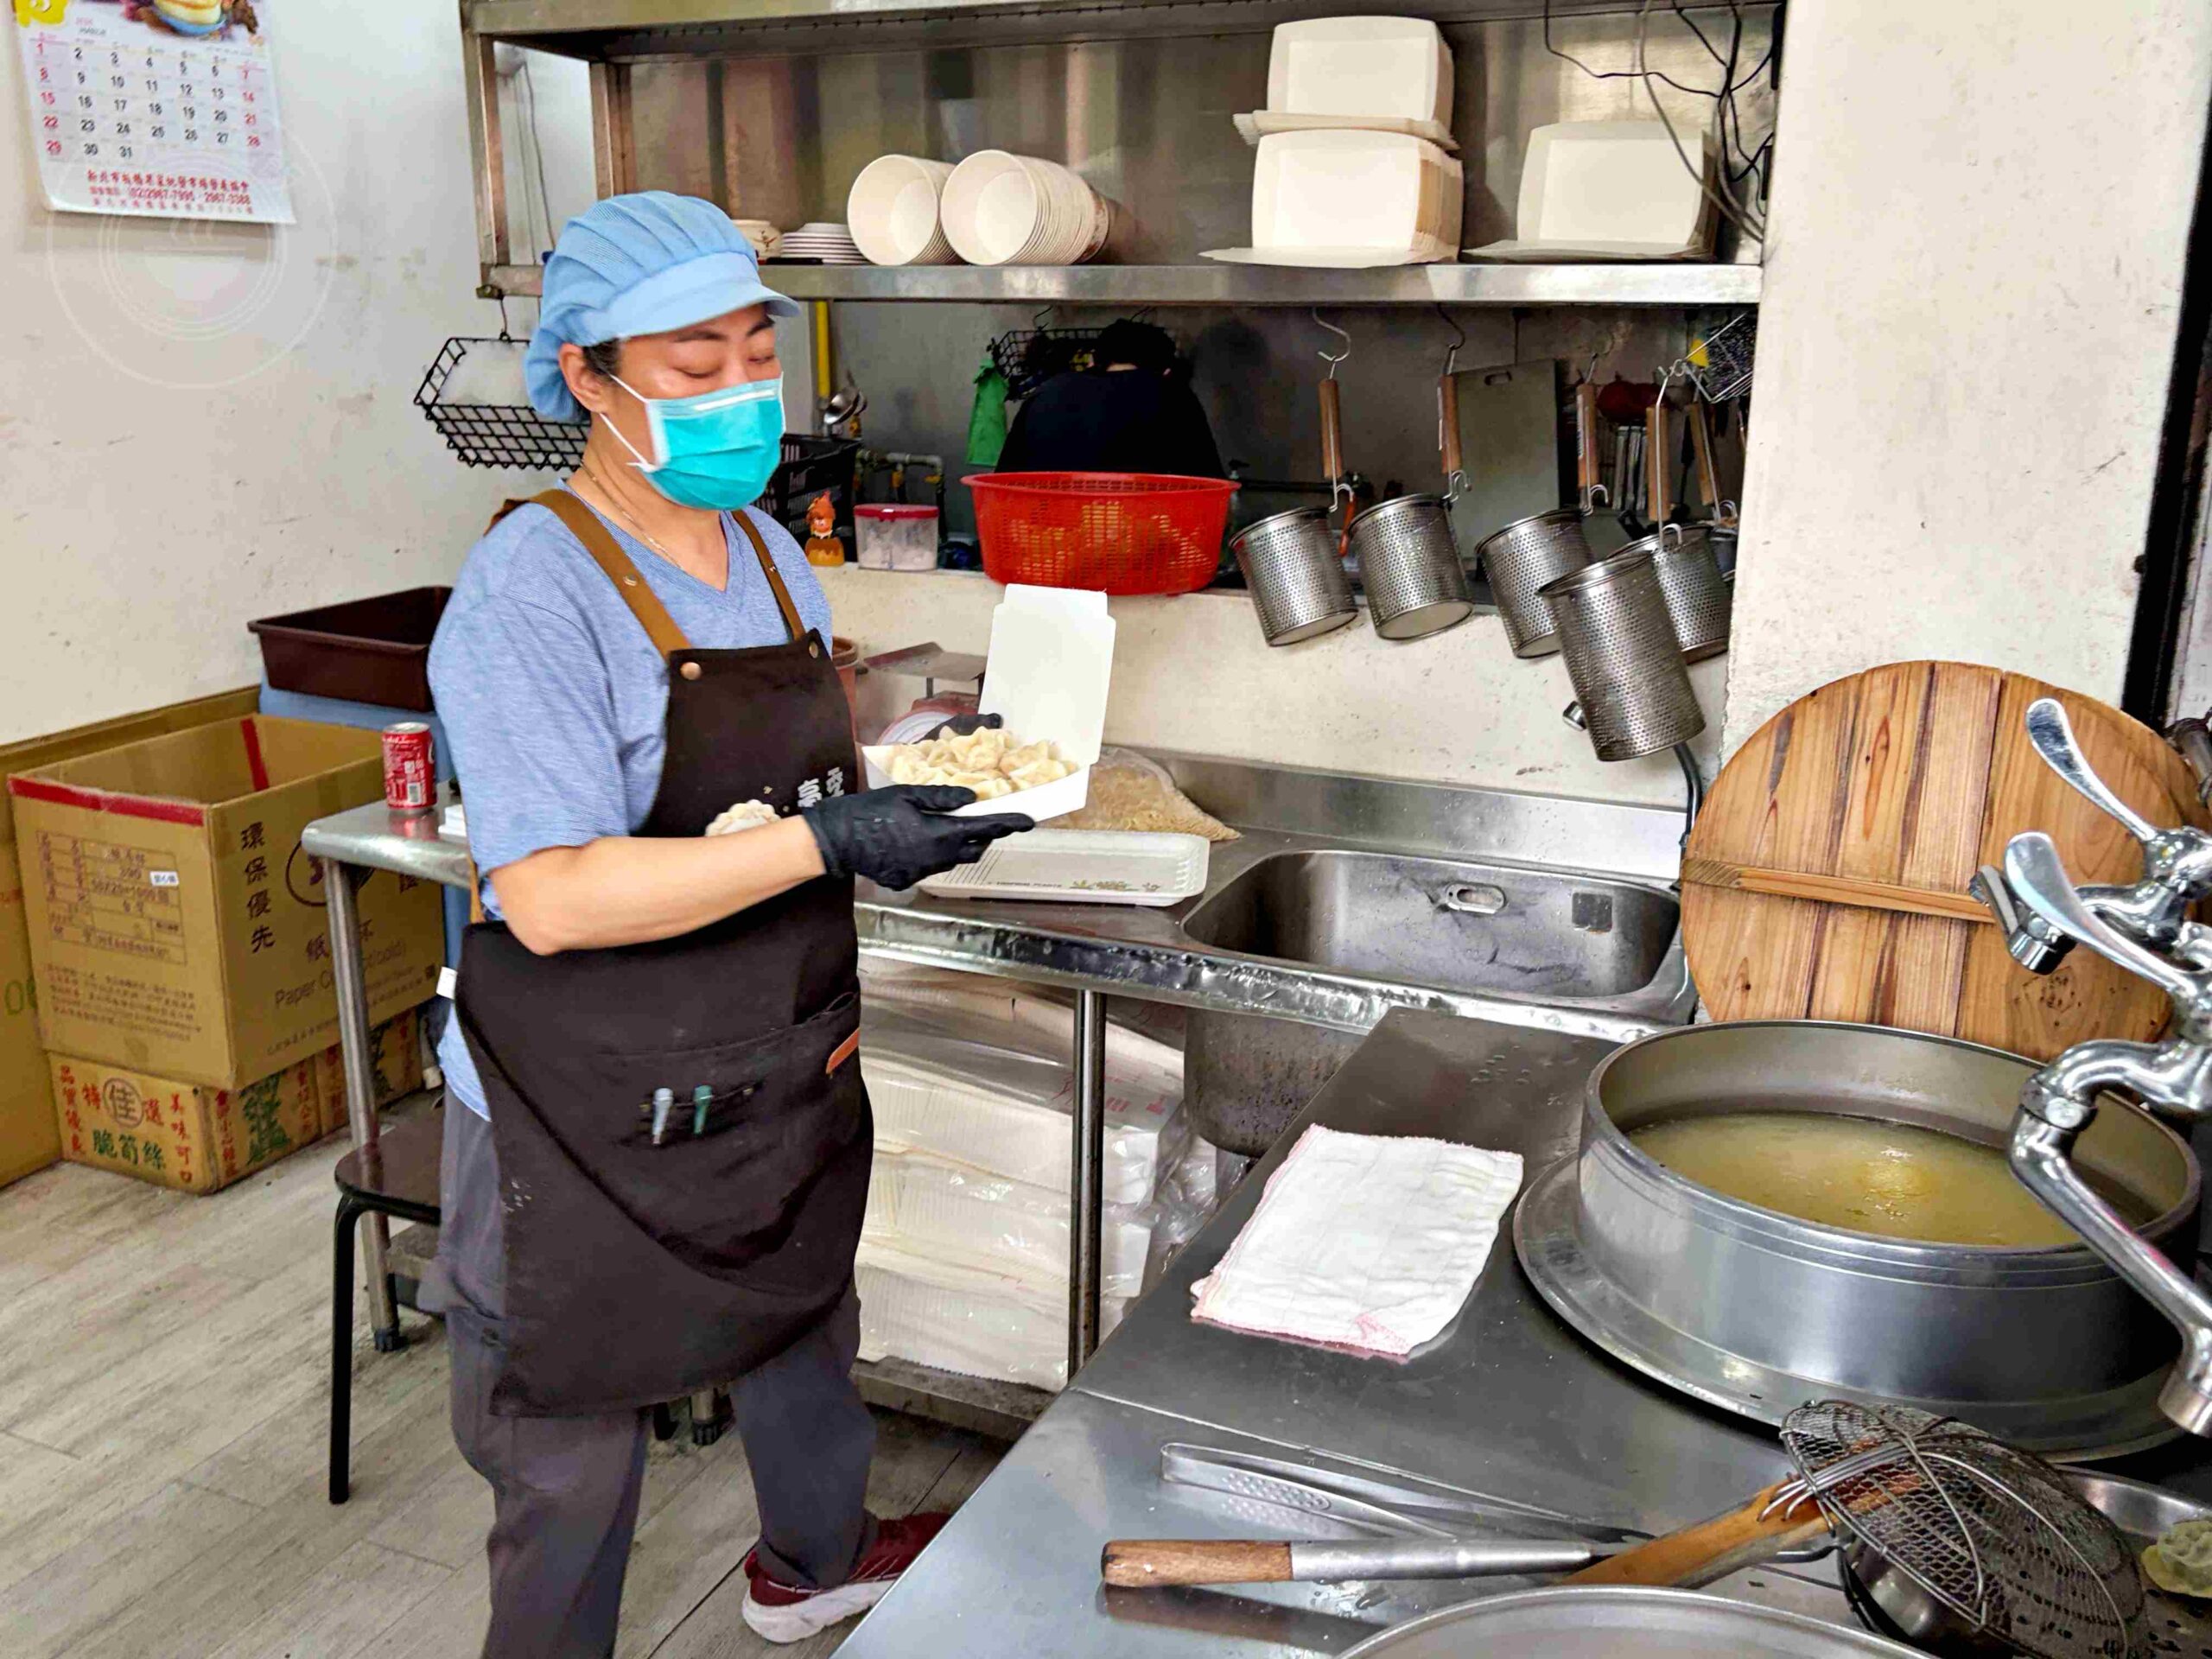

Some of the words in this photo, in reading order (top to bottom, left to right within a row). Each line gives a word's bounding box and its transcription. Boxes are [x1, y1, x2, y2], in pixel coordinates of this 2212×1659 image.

[35, 42, 43, 55] 1
[73, 47, 83, 60] 2
[146, 56, 154, 68] 4
[211, 65, 219, 77] 6
[77, 71, 86, 85] 9
[110, 75, 125, 88] 10
[145, 79, 158, 92] 11
[180, 83, 193, 97] 12
[212, 87, 225, 100] 13
[242, 91, 255, 103] 14
[40, 91, 56, 105] 15
[78, 95, 93, 109] 16
[113, 99, 128, 111] 17
[149, 102, 162, 116] 18
[182, 105, 195, 120] 19
[214, 110, 227, 123] 20
[245, 112, 257, 125] 21
[42, 115, 59, 130] 22
[80, 118, 96, 133] 23
[116, 121, 131, 135] 24
[151, 125, 165, 138] 25
[184, 128, 199, 142] 26
[216, 131, 229, 144] 27
[247, 135, 261, 148] 28
[84, 143, 99, 156] 30
[119, 145, 133, 158] 31
[240, 822, 276, 954] 環保優先
[275, 980, 316, 1009] Paper
[170, 1093, 194, 1184] 美味可口
